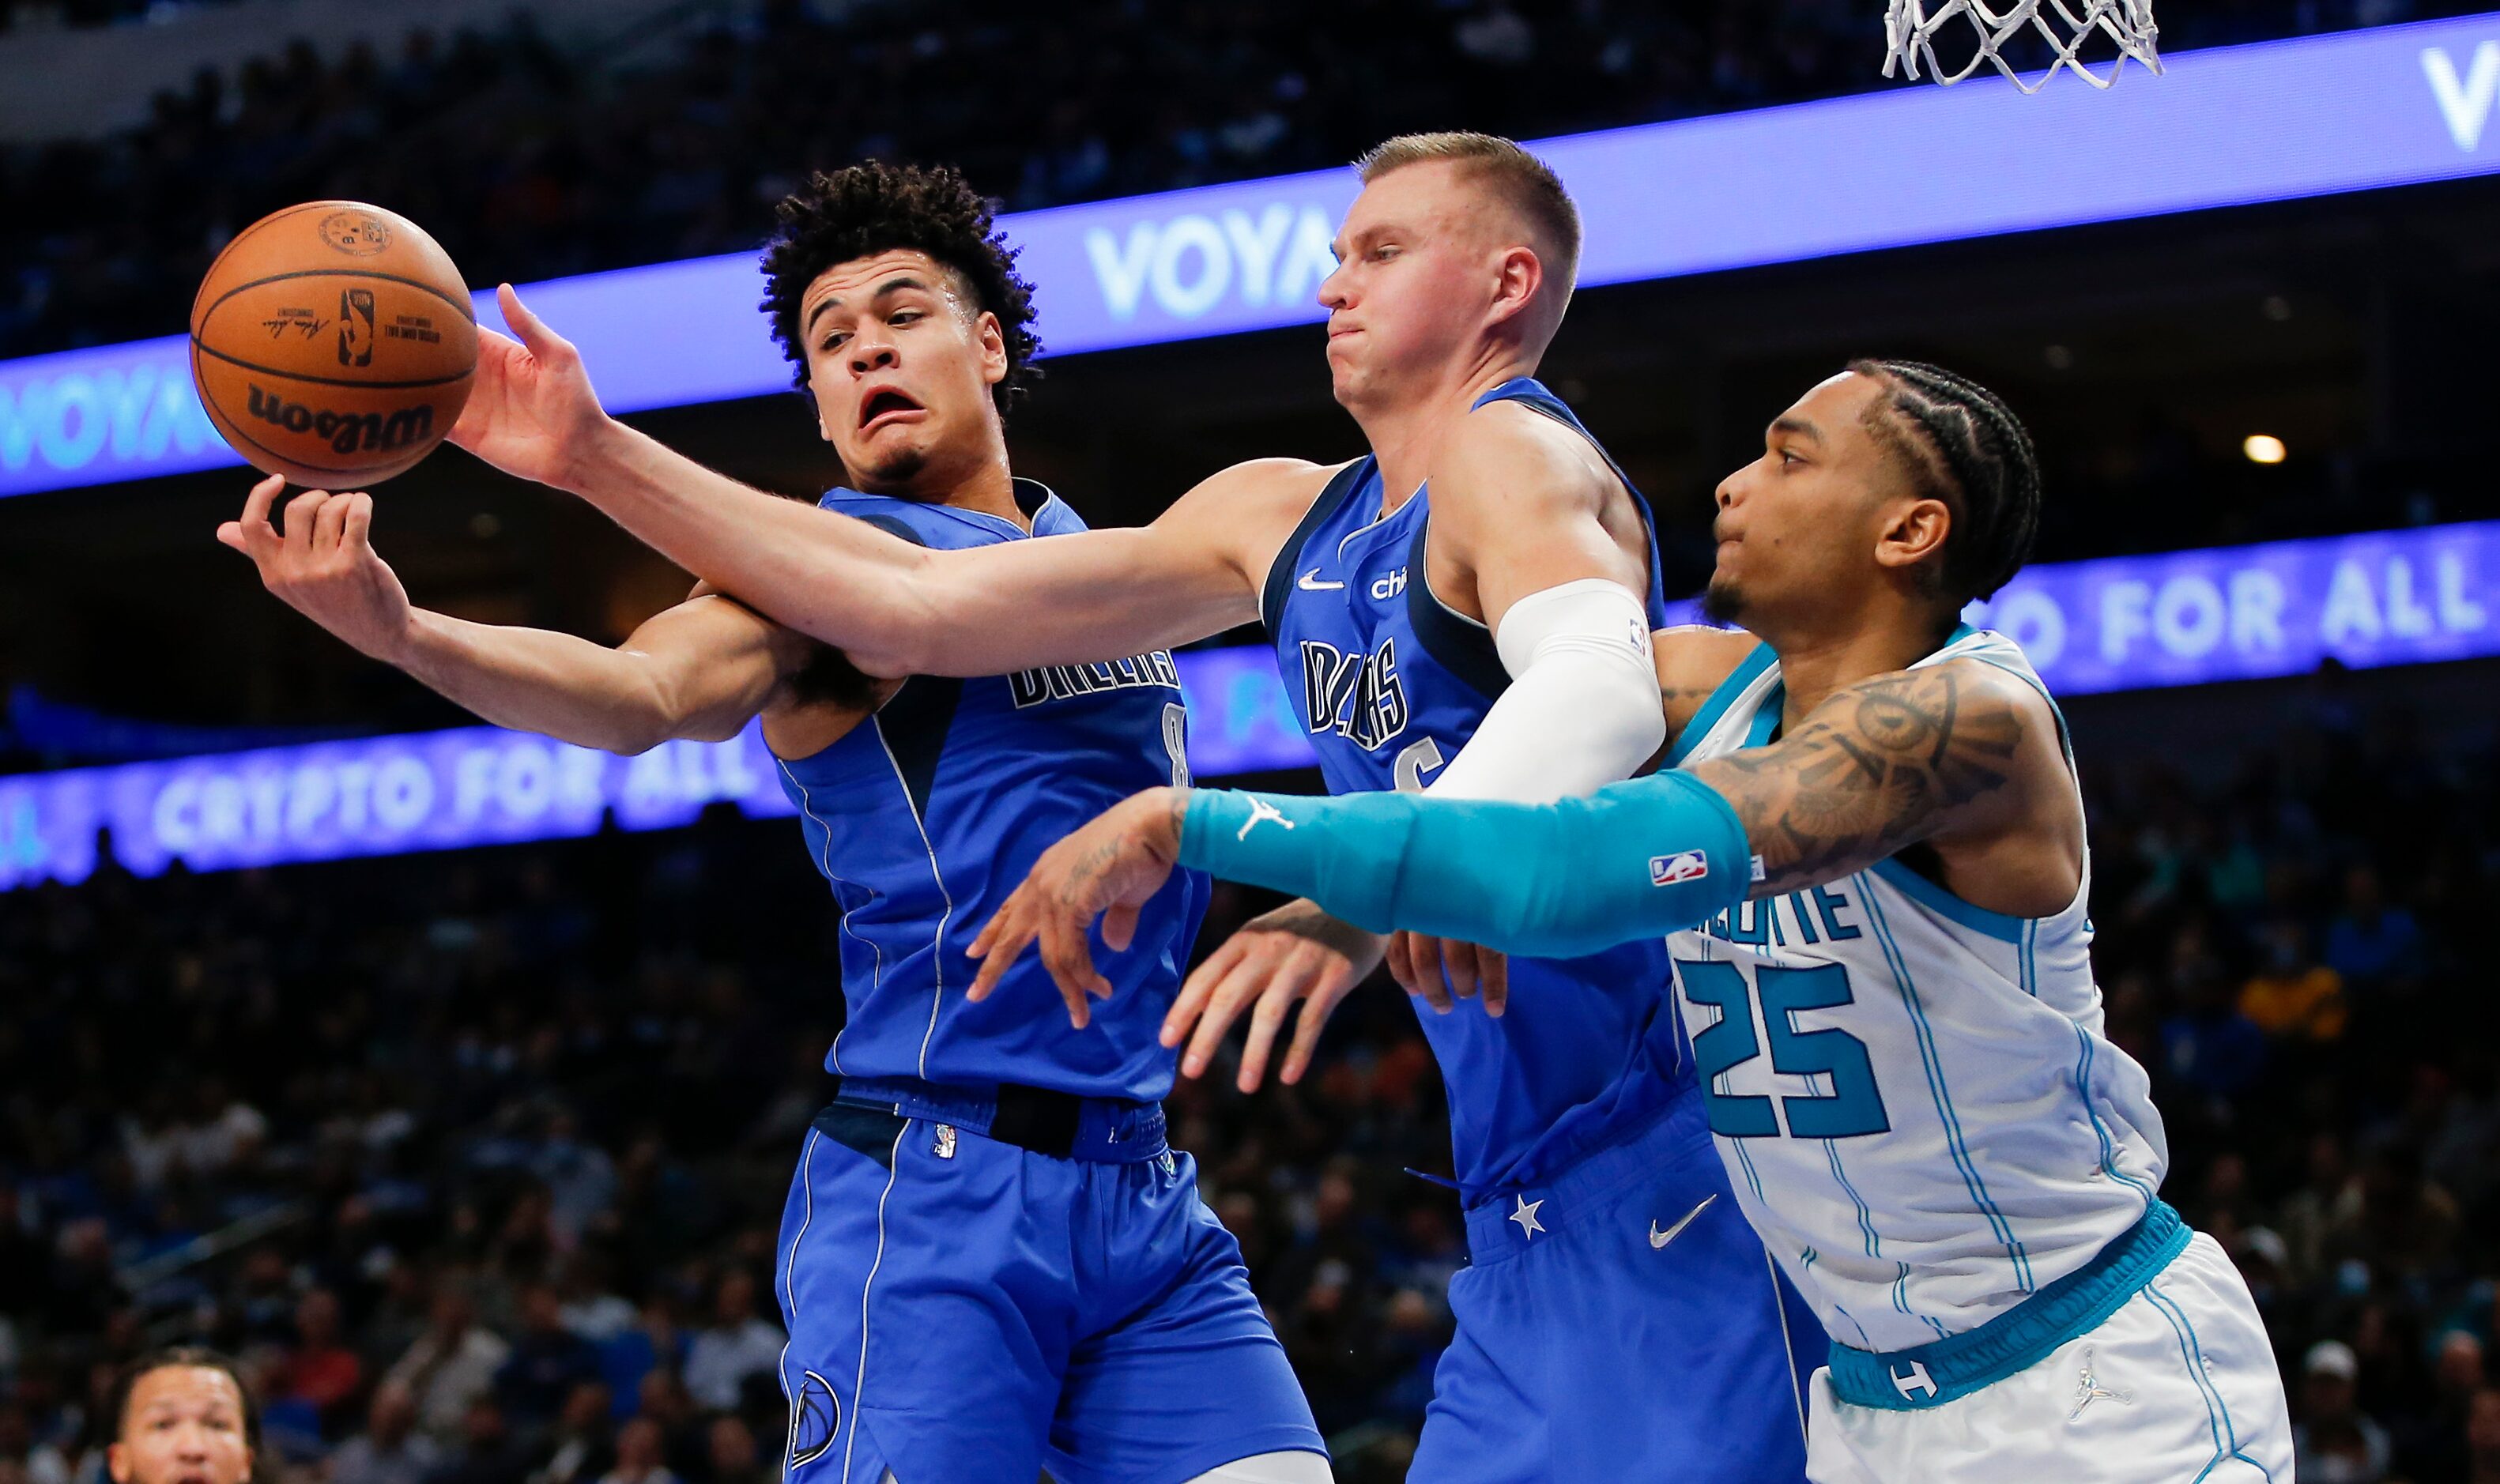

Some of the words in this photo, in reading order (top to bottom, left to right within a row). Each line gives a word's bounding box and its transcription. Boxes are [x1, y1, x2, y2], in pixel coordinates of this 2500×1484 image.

[2421, 40, 2500, 153] V
[1083, 202, 1338, 319] VOYA
[247, 382, 435, 455] Wilson
[1371, 565, 1408, 600] chi
[2098, 565, 2287, 667] FOR
[2319, 553, 2490, 646] ALL
[153, 755, 435, 855] CRYPTO
[454, 740, 605, 823] FOR
[1673, 959, 1891, 1139] 25
